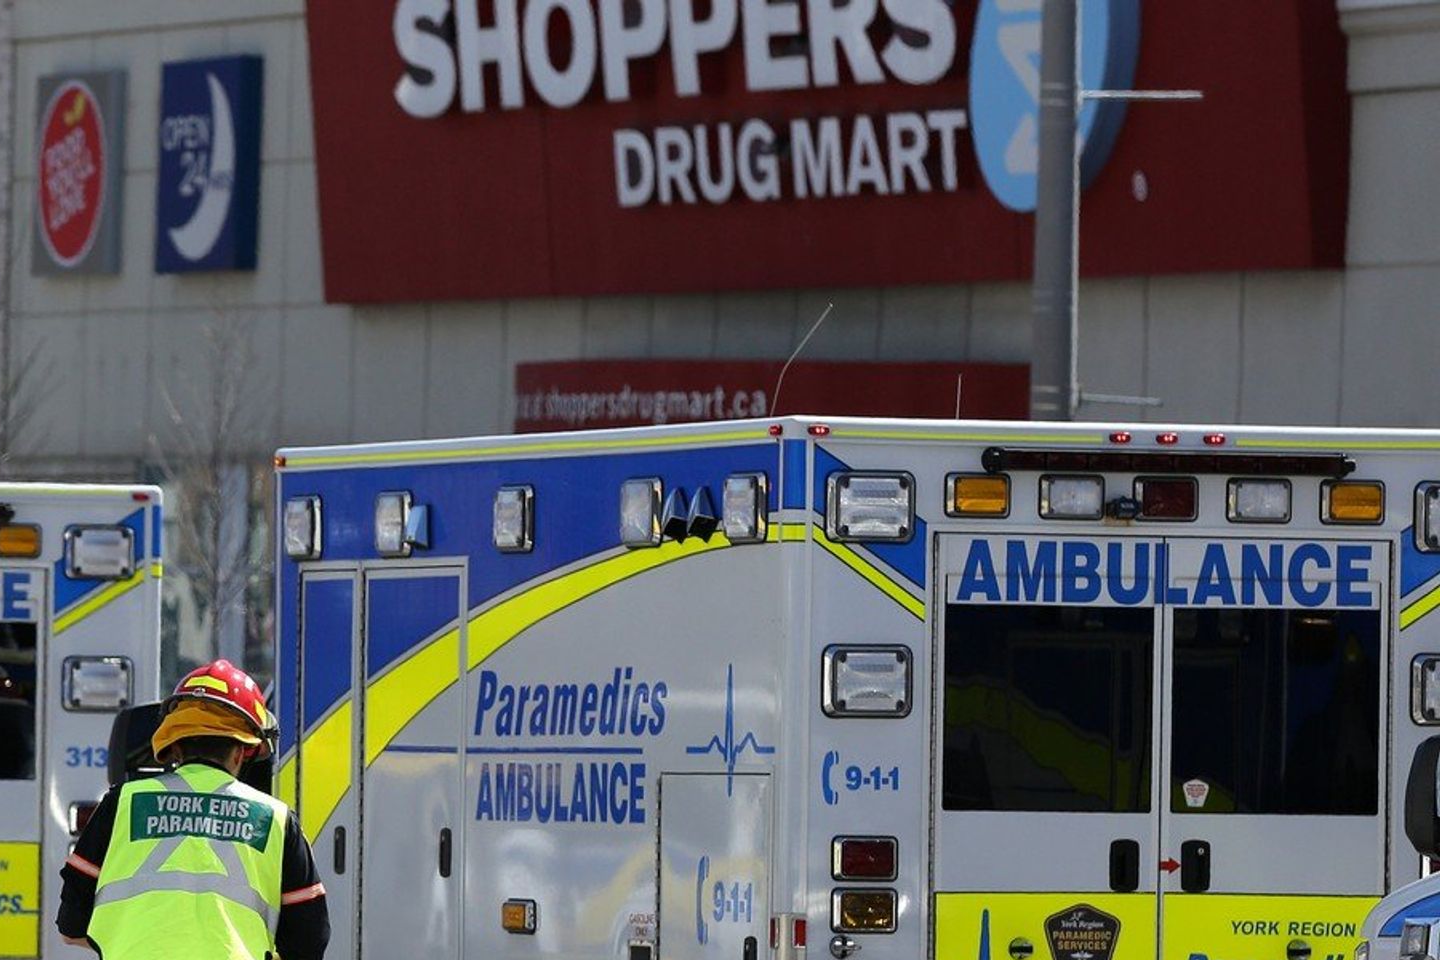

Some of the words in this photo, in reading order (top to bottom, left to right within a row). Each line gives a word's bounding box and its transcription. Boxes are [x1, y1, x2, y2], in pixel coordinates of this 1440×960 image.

[393, 0, 957, 118] SHOPPERS
[613, 118, 781, 207] DRUG
[791, 108, 967, 198] MART
[544, 384, 767, 424] shoppersdrugmart.ca
[956, 539, 1373, 608] AMBULANCE
[474, 667, 668, 737] Paramedics
[66, 747, 108, 769] 313
[476, 762, 647, 824] AMBULANCE
[845, 766, 900, 791] 9-1-1
[157, 795, 204, 813] YORK
[209, 798, 250, 819] EMS
[147, 815, 254, 840] PARAMEDIC
[712, 881, 753, 923] 9-1-1
[1053, 930, 1112, 940] PARAMEDIC
[1232, 921, 1280, 936] YORK
[1287, 921, 1357, 937] REGION
[1057, 940, 1108, 951] SERVICES
